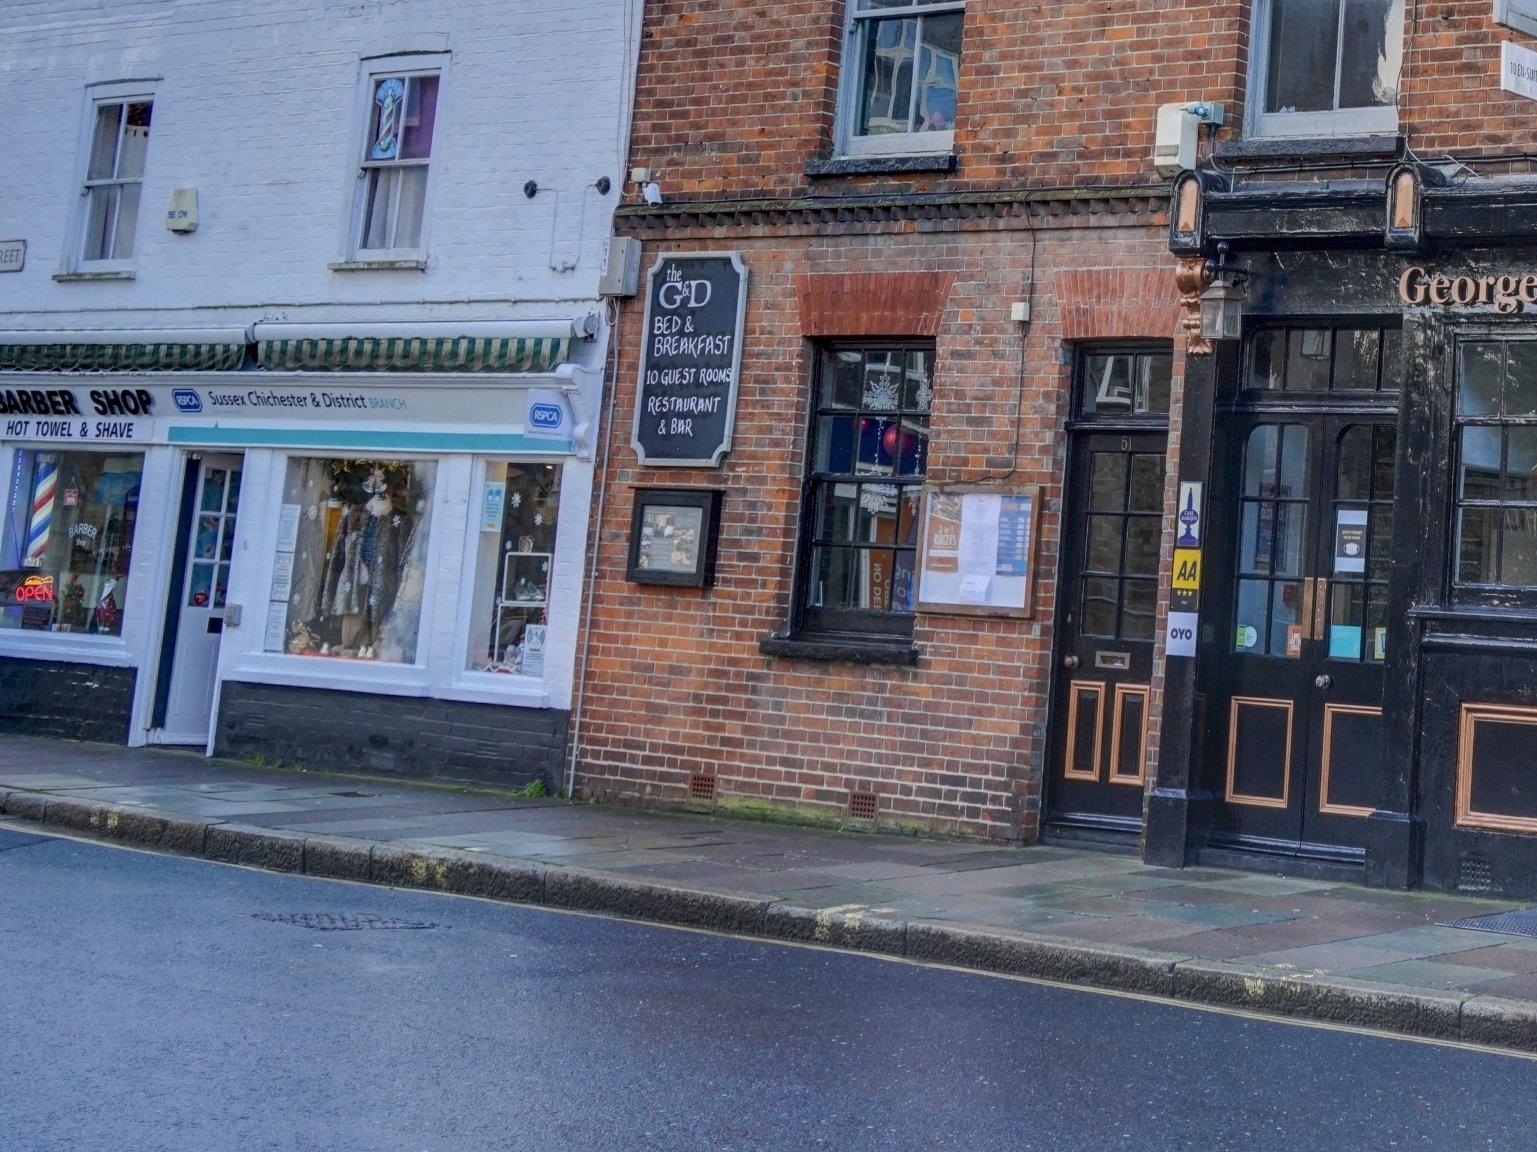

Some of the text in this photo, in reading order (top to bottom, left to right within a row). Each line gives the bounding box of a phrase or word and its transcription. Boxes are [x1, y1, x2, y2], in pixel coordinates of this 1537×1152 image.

[667, 264, 682, 281] the
[653, 316, 694, 334] BED &
[654, 335, 731, 357] BREAKFAST
[646, 367, 732, 386] 10 GUEST ROOMS
[90, 389, 153, 416] SHOP
[208, 391, 246, 407] Sussex
[249, 391, 308, 408] Chichester
[312, 393, 321, 408] &
[323, 393, 368, 409] District
[648, 396, 721, 415] RESTAURANT
[534, 410, 558, 421] RSPCA
[6, 420, 134, 438] HOT TOWEL & SHAVE
[658, 418, 693, 437] & BAR
[69, 523, 97, 539] BARBER
[1177, 560, 1197, 581] AA
[1171, 628, 1193, 640] OYO
